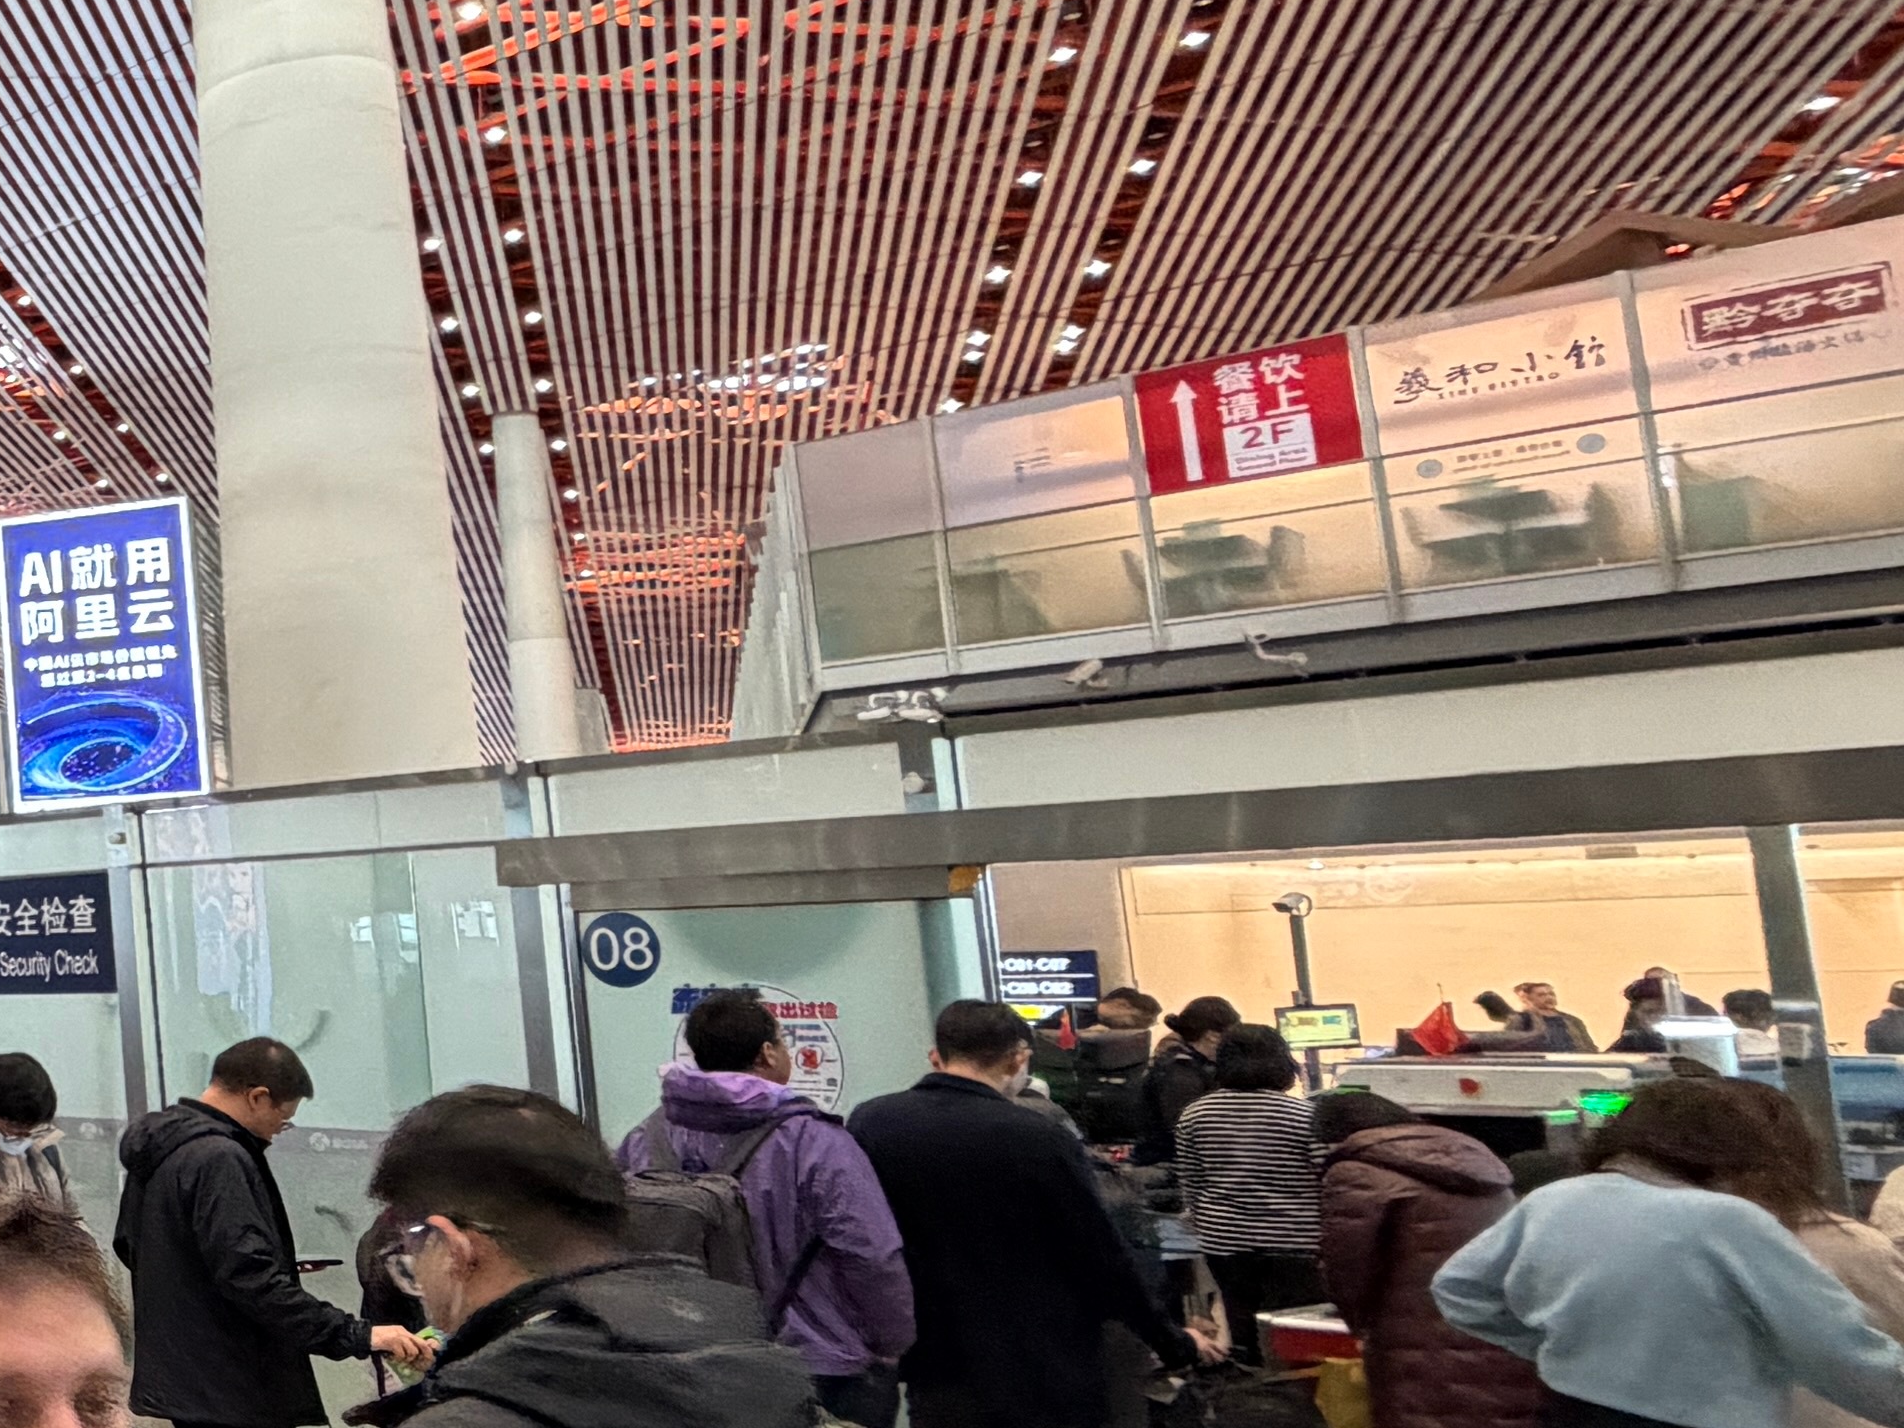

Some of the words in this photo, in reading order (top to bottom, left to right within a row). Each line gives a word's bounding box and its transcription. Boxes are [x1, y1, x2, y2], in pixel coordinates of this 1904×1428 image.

[1213, 353, 1305, 395] 餐饮
[1217, 384, 1310, 424] 请上
[1240, 421, 1294, 449] 2F
[19, 537, 171, 597] AI就用
[20, 588, 175, 646] 阿里云
[0, 950, 52, 983] Security
[54, 948, 100, 976] Check
[589, 926, 655, 971] 08
